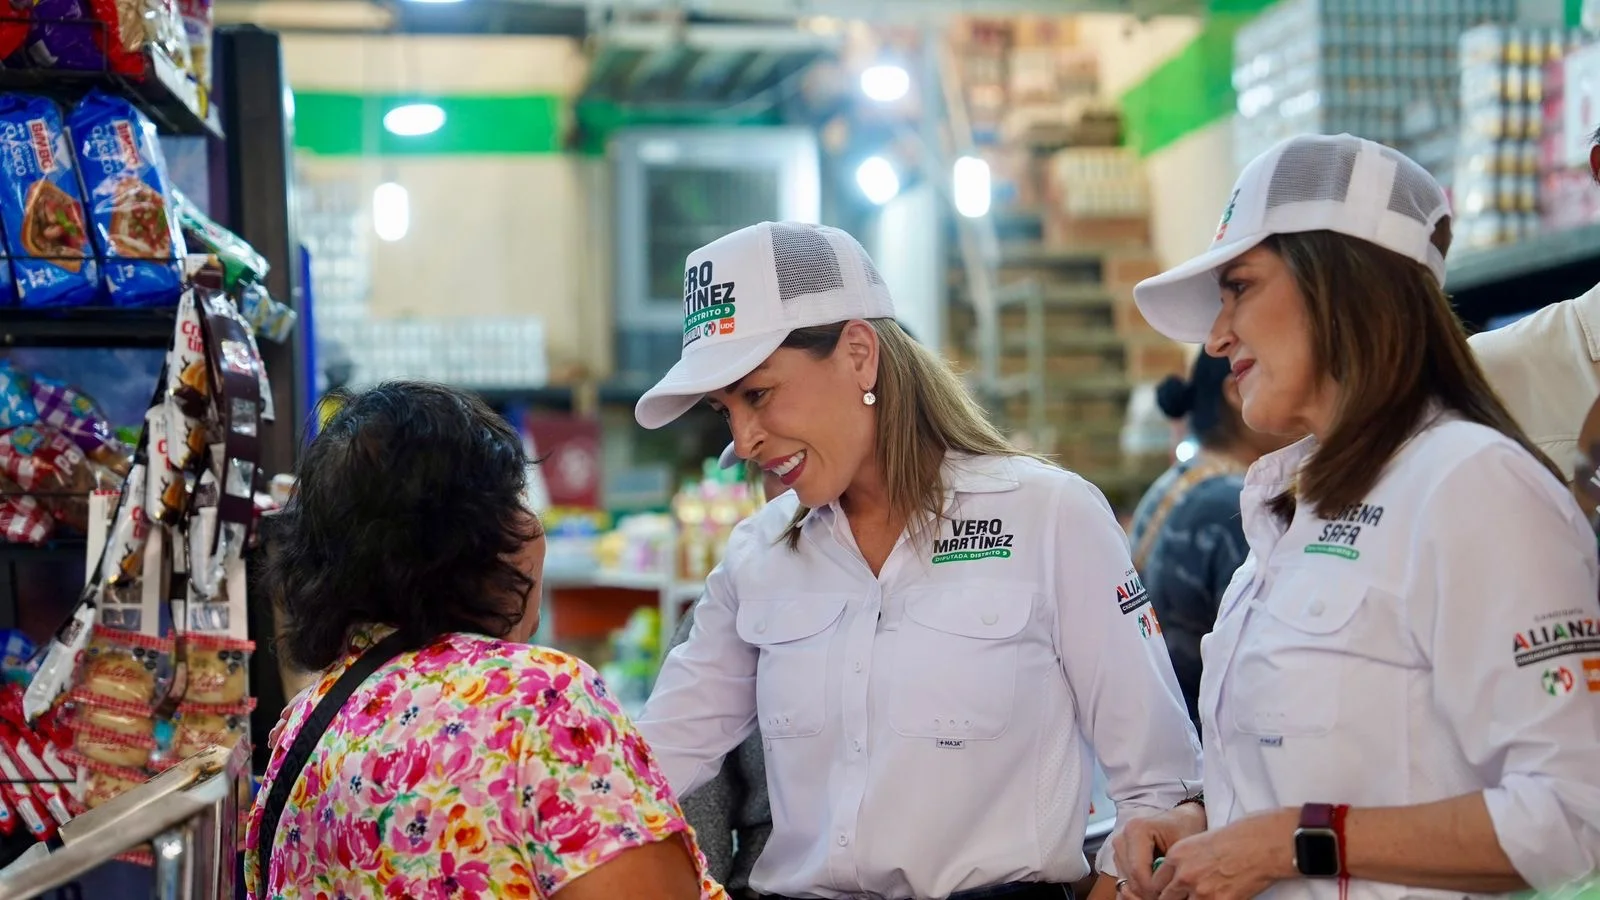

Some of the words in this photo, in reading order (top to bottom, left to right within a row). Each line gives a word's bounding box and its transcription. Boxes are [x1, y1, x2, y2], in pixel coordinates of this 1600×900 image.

[31, 121, 53, 170] BIMBO
[687, 308, 721, 326] DISTRITO
[724, 306, 731, 315] 9
[951, 518, 1003, 537] VERO
[1318, 523, 1362, 546] SAFA
[933, 533, 1014, 554] MARTÍNEZ
[935, 553, 968, 562] DIPUTADA
[970, 550, 1000, 559] DISTRITO
